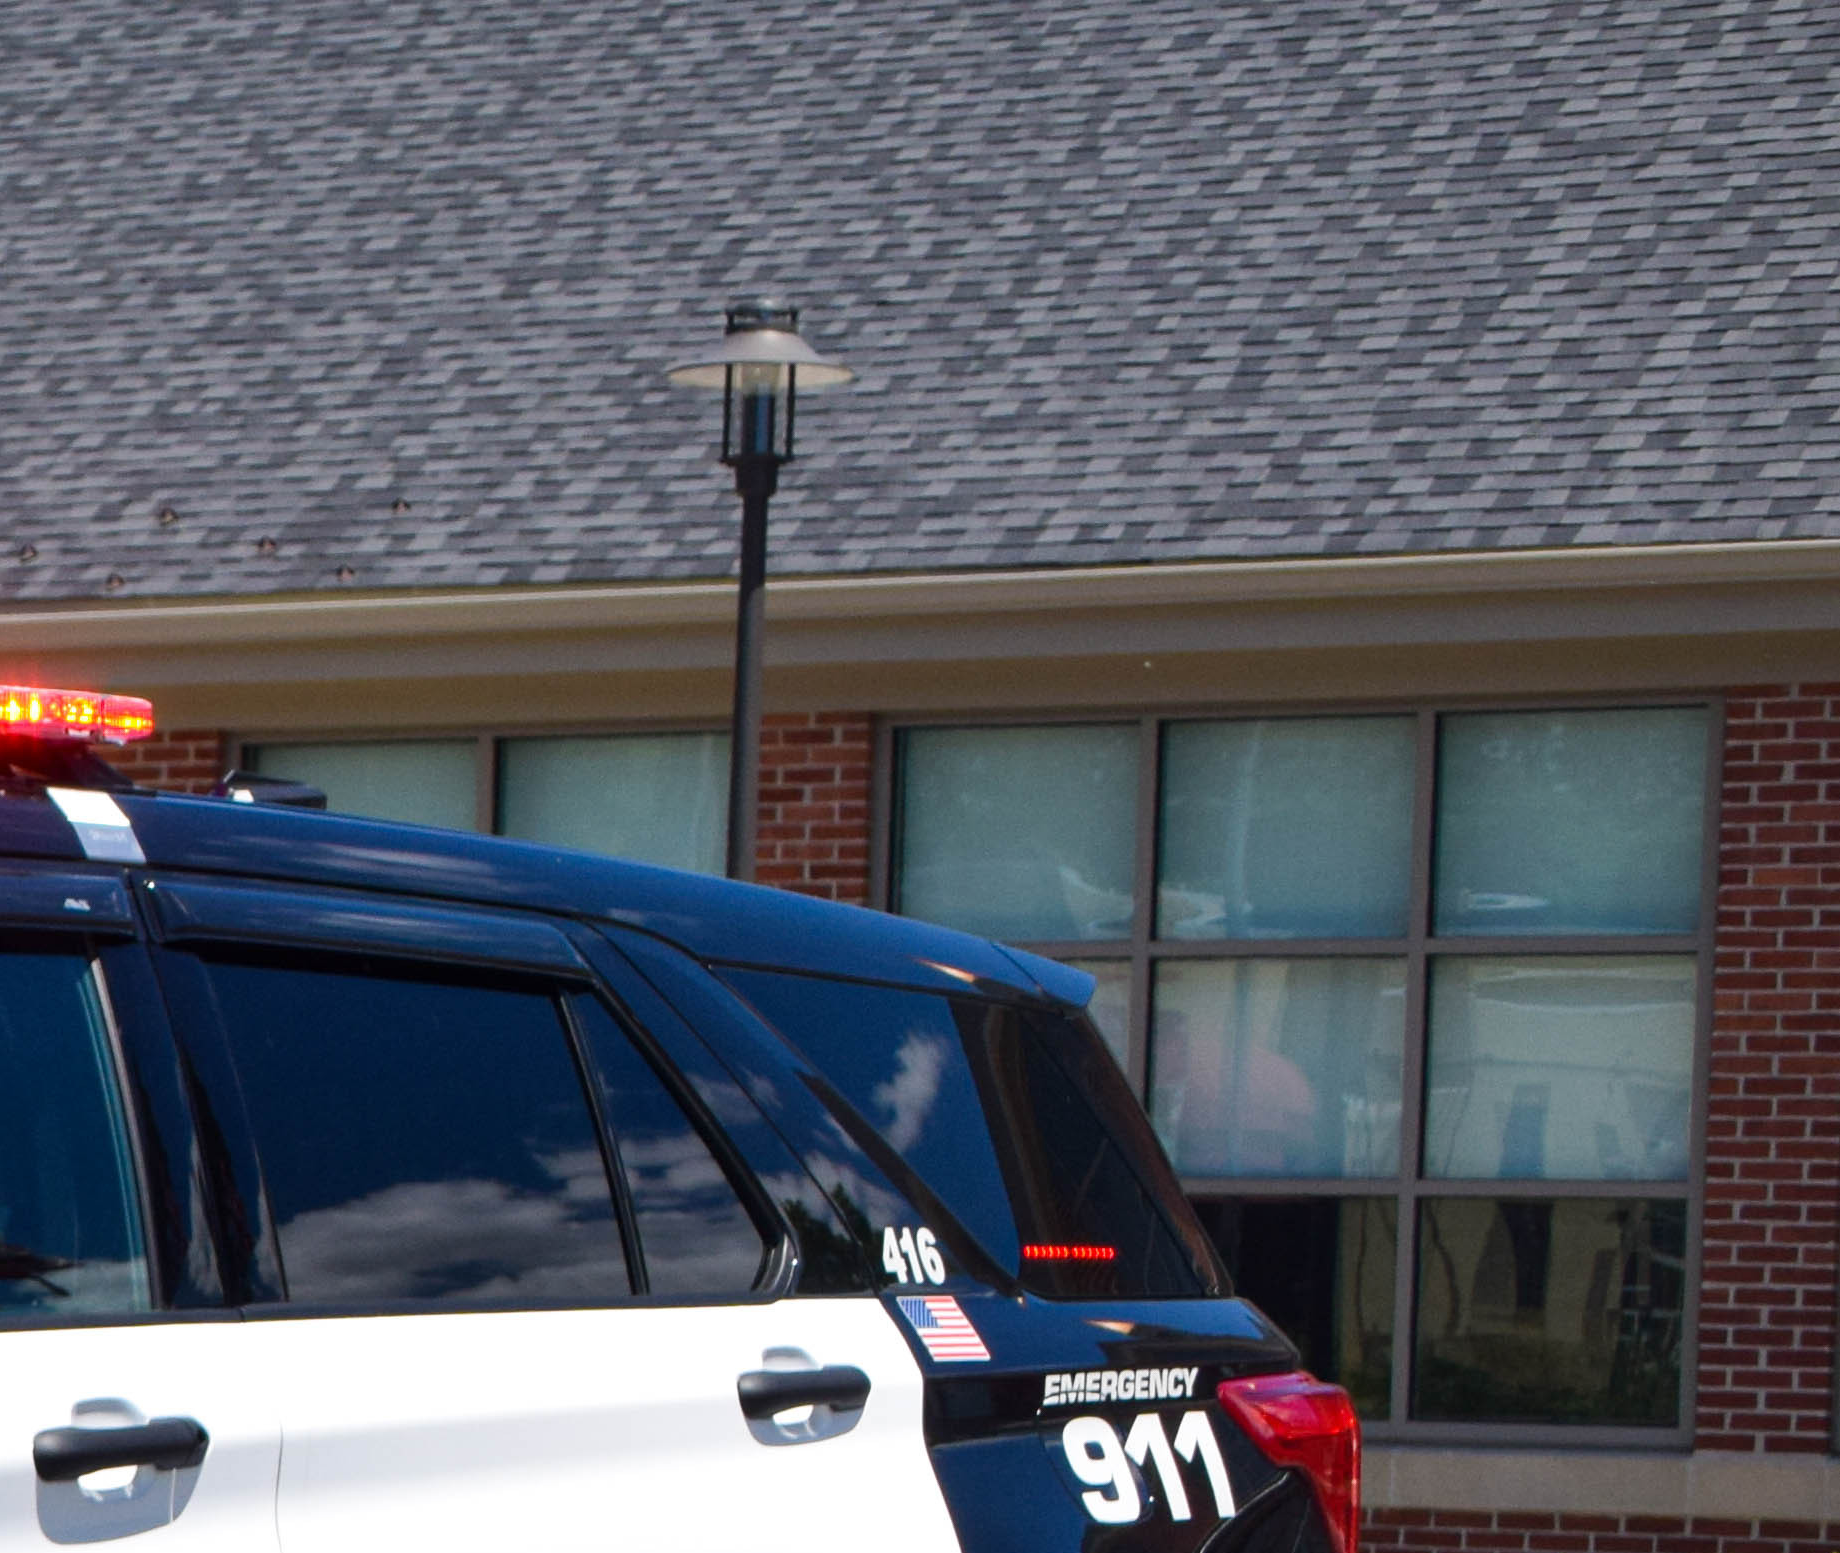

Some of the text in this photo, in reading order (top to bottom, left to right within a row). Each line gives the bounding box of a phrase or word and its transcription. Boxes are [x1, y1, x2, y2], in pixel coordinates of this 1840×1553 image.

[882, 1226, 945, 1285] 416
[1043, 1366, 1199, 1407] EMERGENCY
[1062, 1410, 1236, 1524] 911
